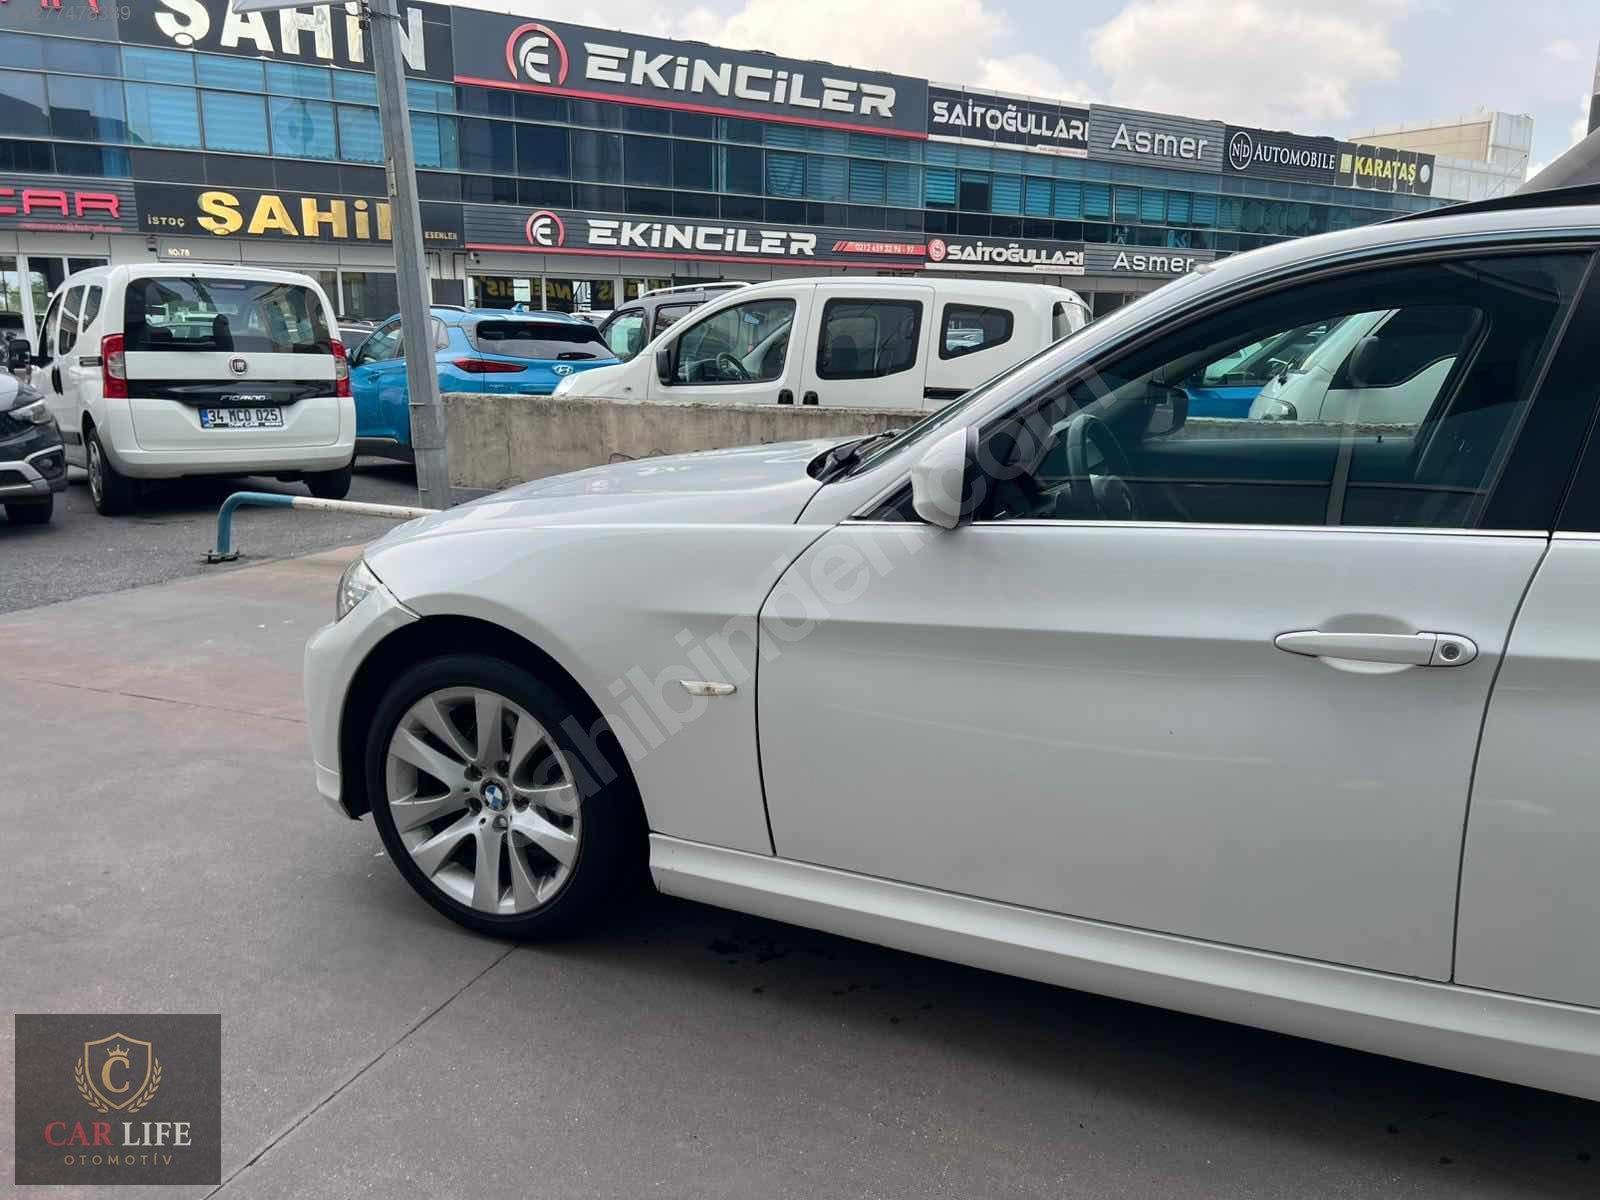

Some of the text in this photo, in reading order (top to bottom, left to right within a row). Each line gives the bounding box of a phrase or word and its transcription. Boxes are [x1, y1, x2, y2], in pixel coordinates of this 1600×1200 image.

[1111, 123, 1207, 160] Asmer
[1253, 144, 1336, 170] AUTOMOBILE
[1354, 155, 1417, 186] KARATAŞ
[1113, 251, 1196, 273] Asmer
[208, 410, 224, 423] 34
[255, 408, 278, 421] 025
